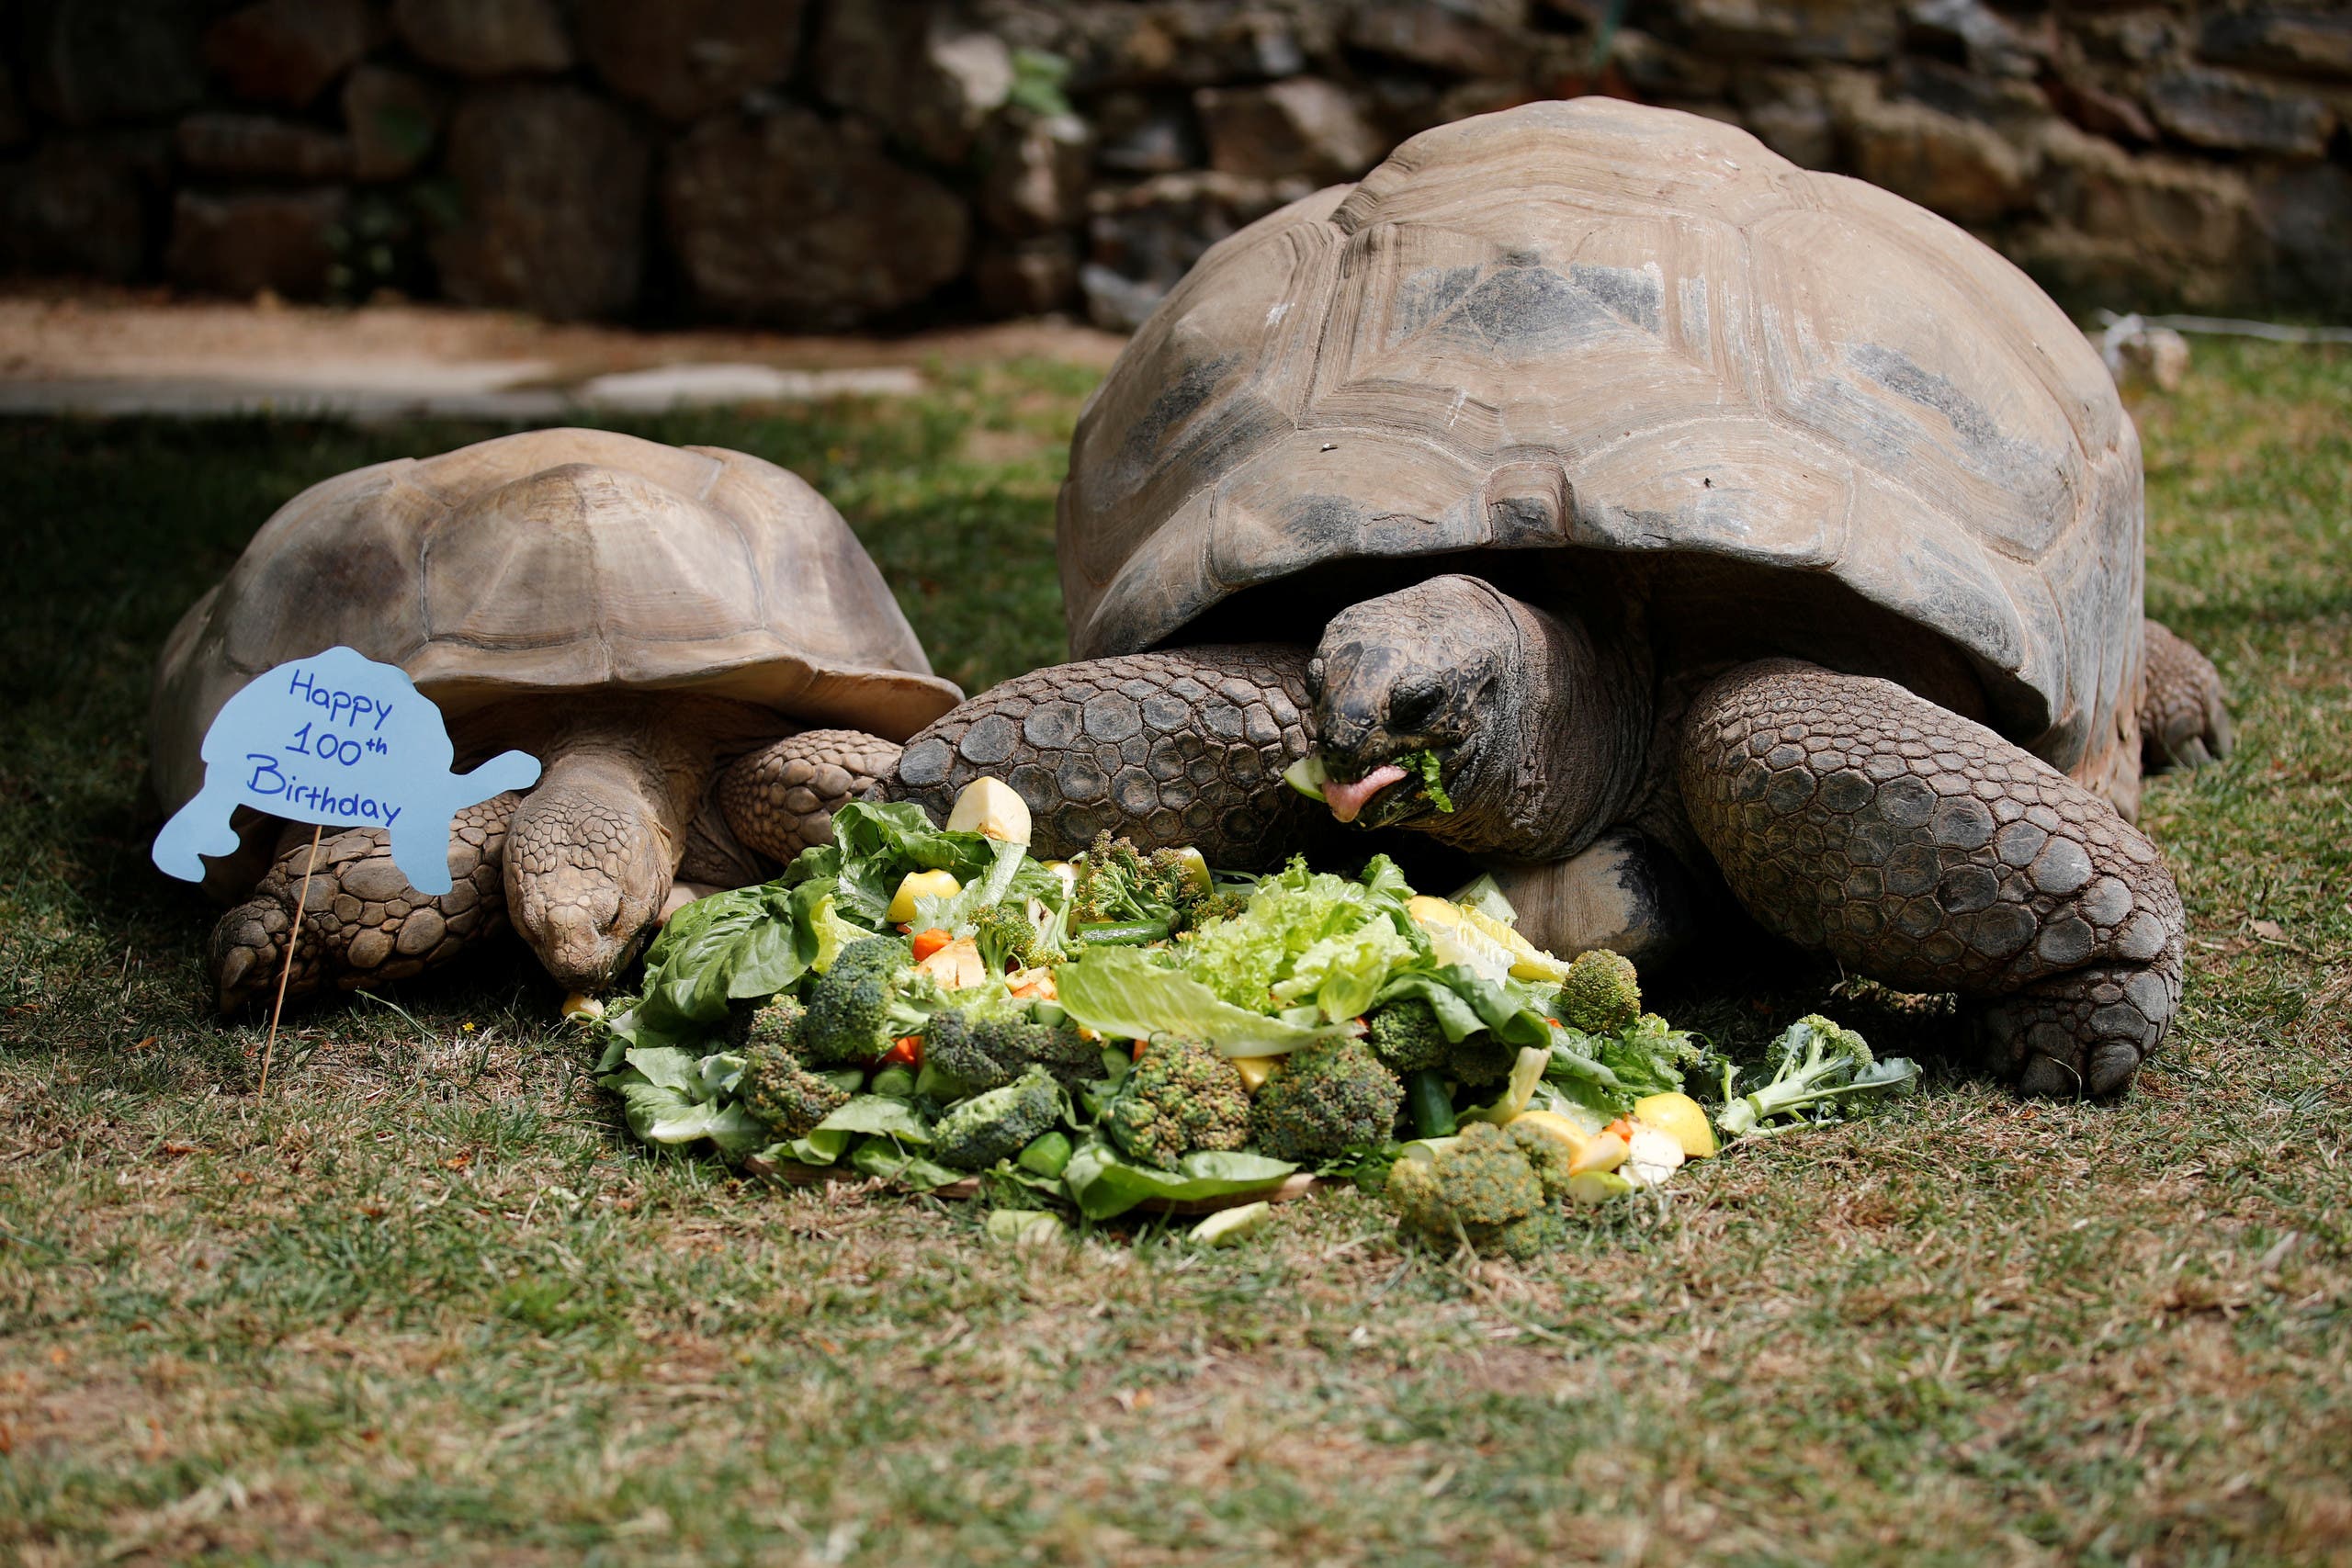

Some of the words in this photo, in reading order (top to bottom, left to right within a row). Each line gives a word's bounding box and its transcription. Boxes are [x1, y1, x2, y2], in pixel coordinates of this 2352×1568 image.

[289, 669, 393, 731] Happy
[285, 721, 388, 767] 100th
[246, 753, 401, 828] Birthday
